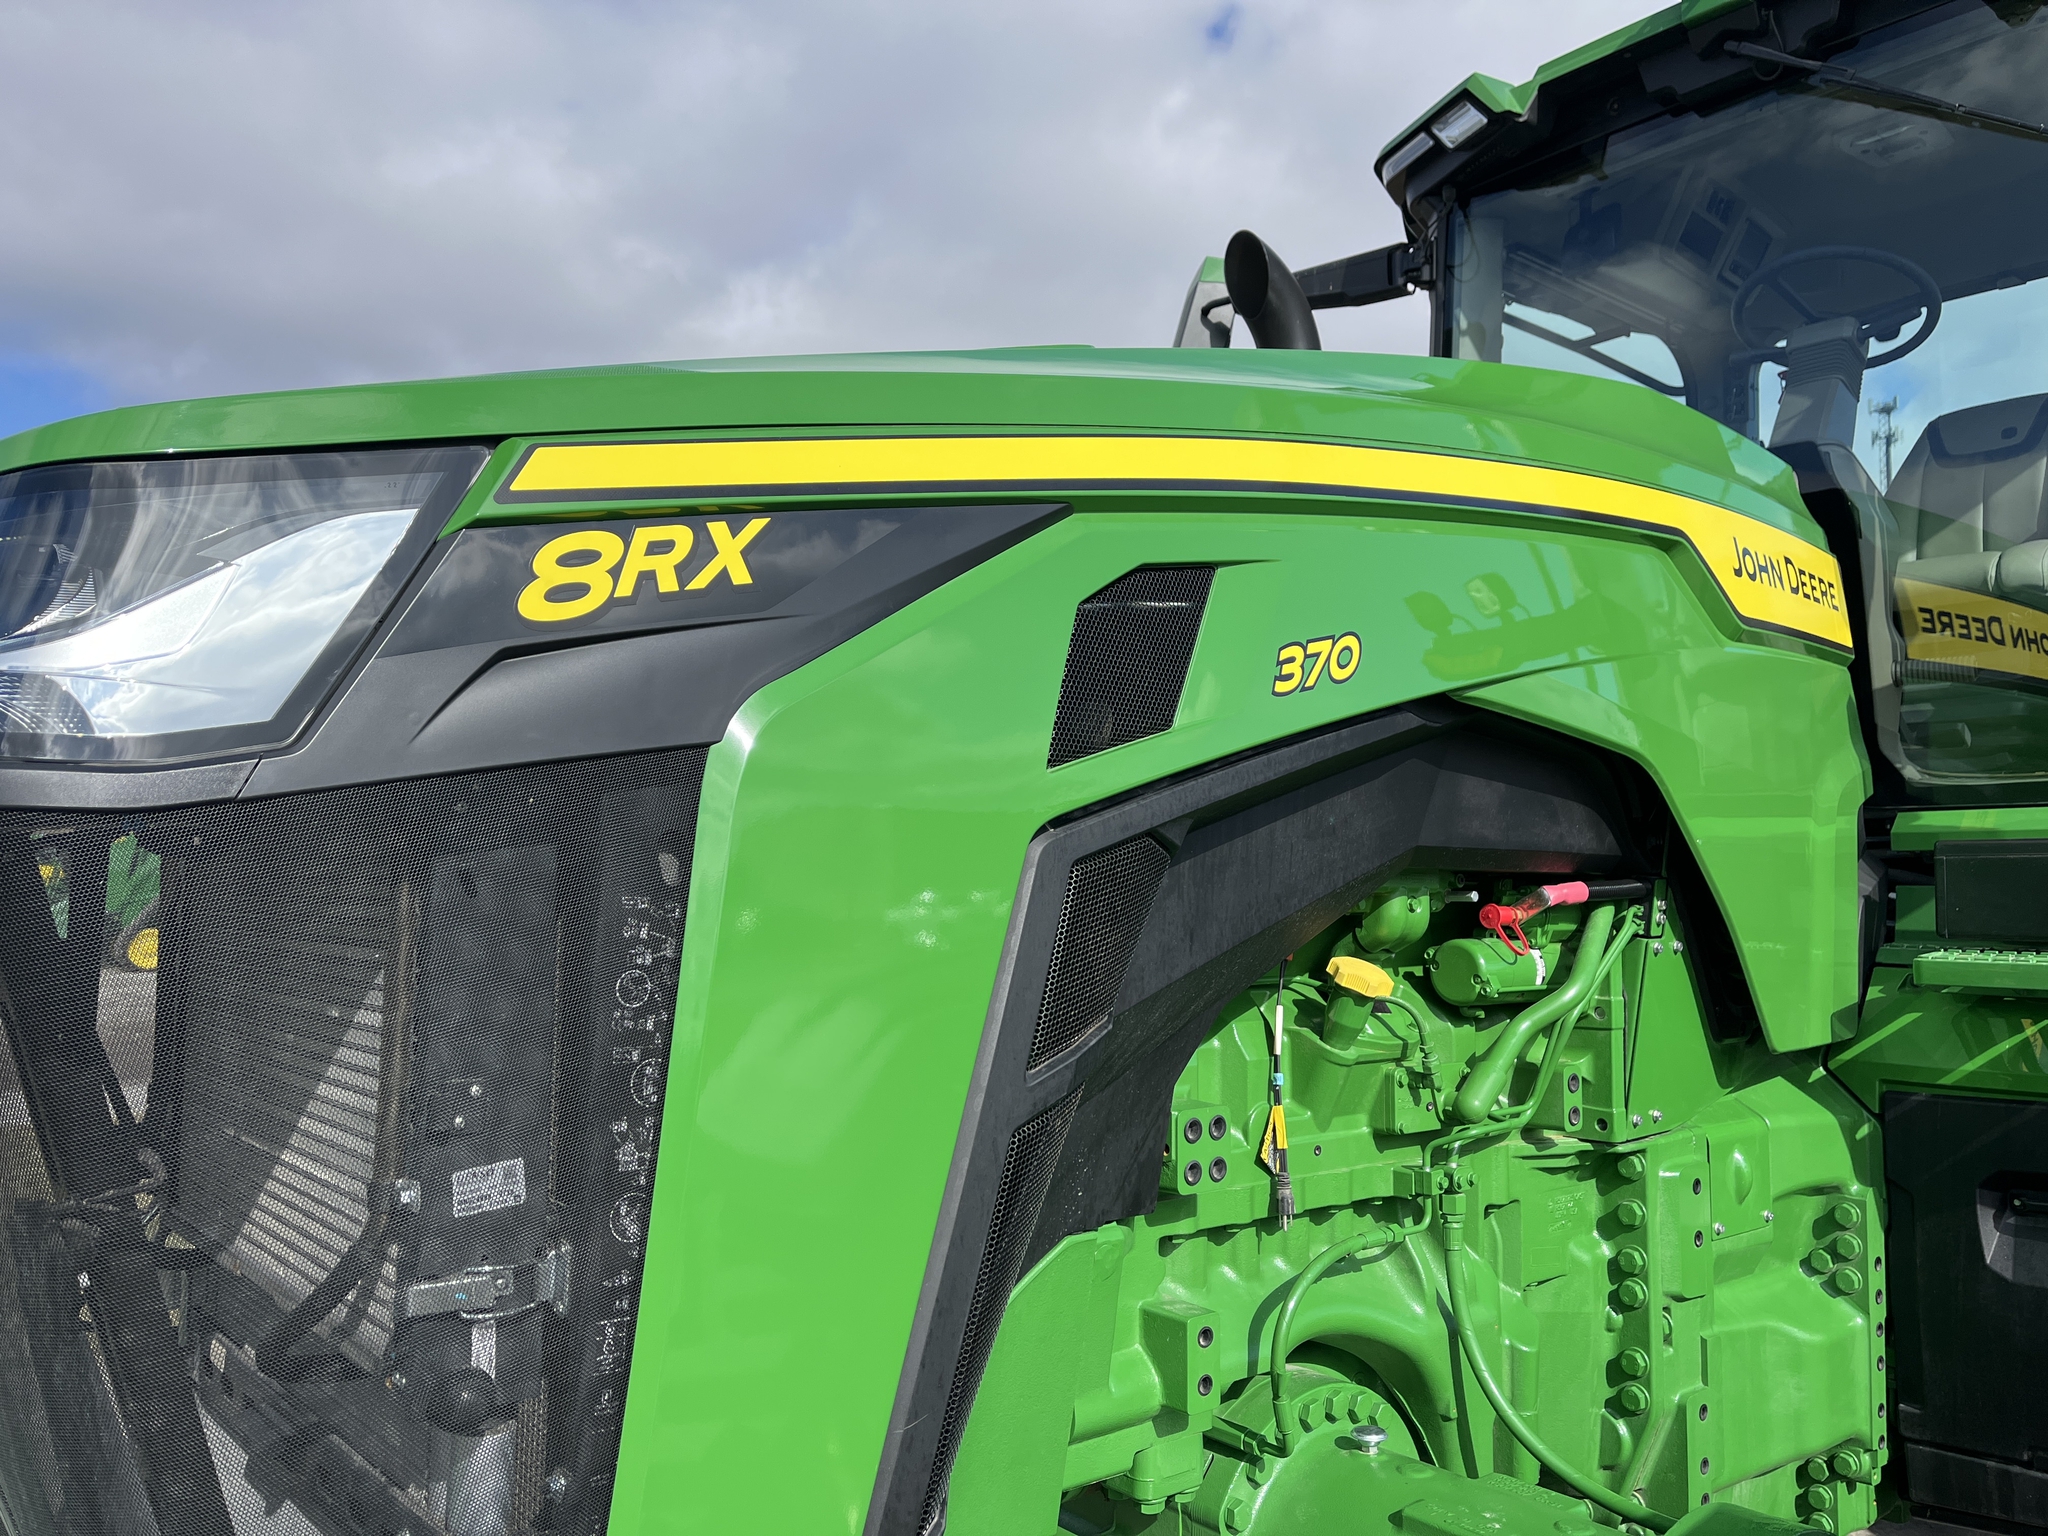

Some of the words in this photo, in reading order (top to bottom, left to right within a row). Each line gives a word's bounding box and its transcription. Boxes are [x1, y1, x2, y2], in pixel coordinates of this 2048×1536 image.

[517, 517, 771, 622] 8RX
[1732, 536, 1785, 591] JOHN
[1783, 556, 1840, 612] DEERE
[1273, 632, 1361, 696] 370
